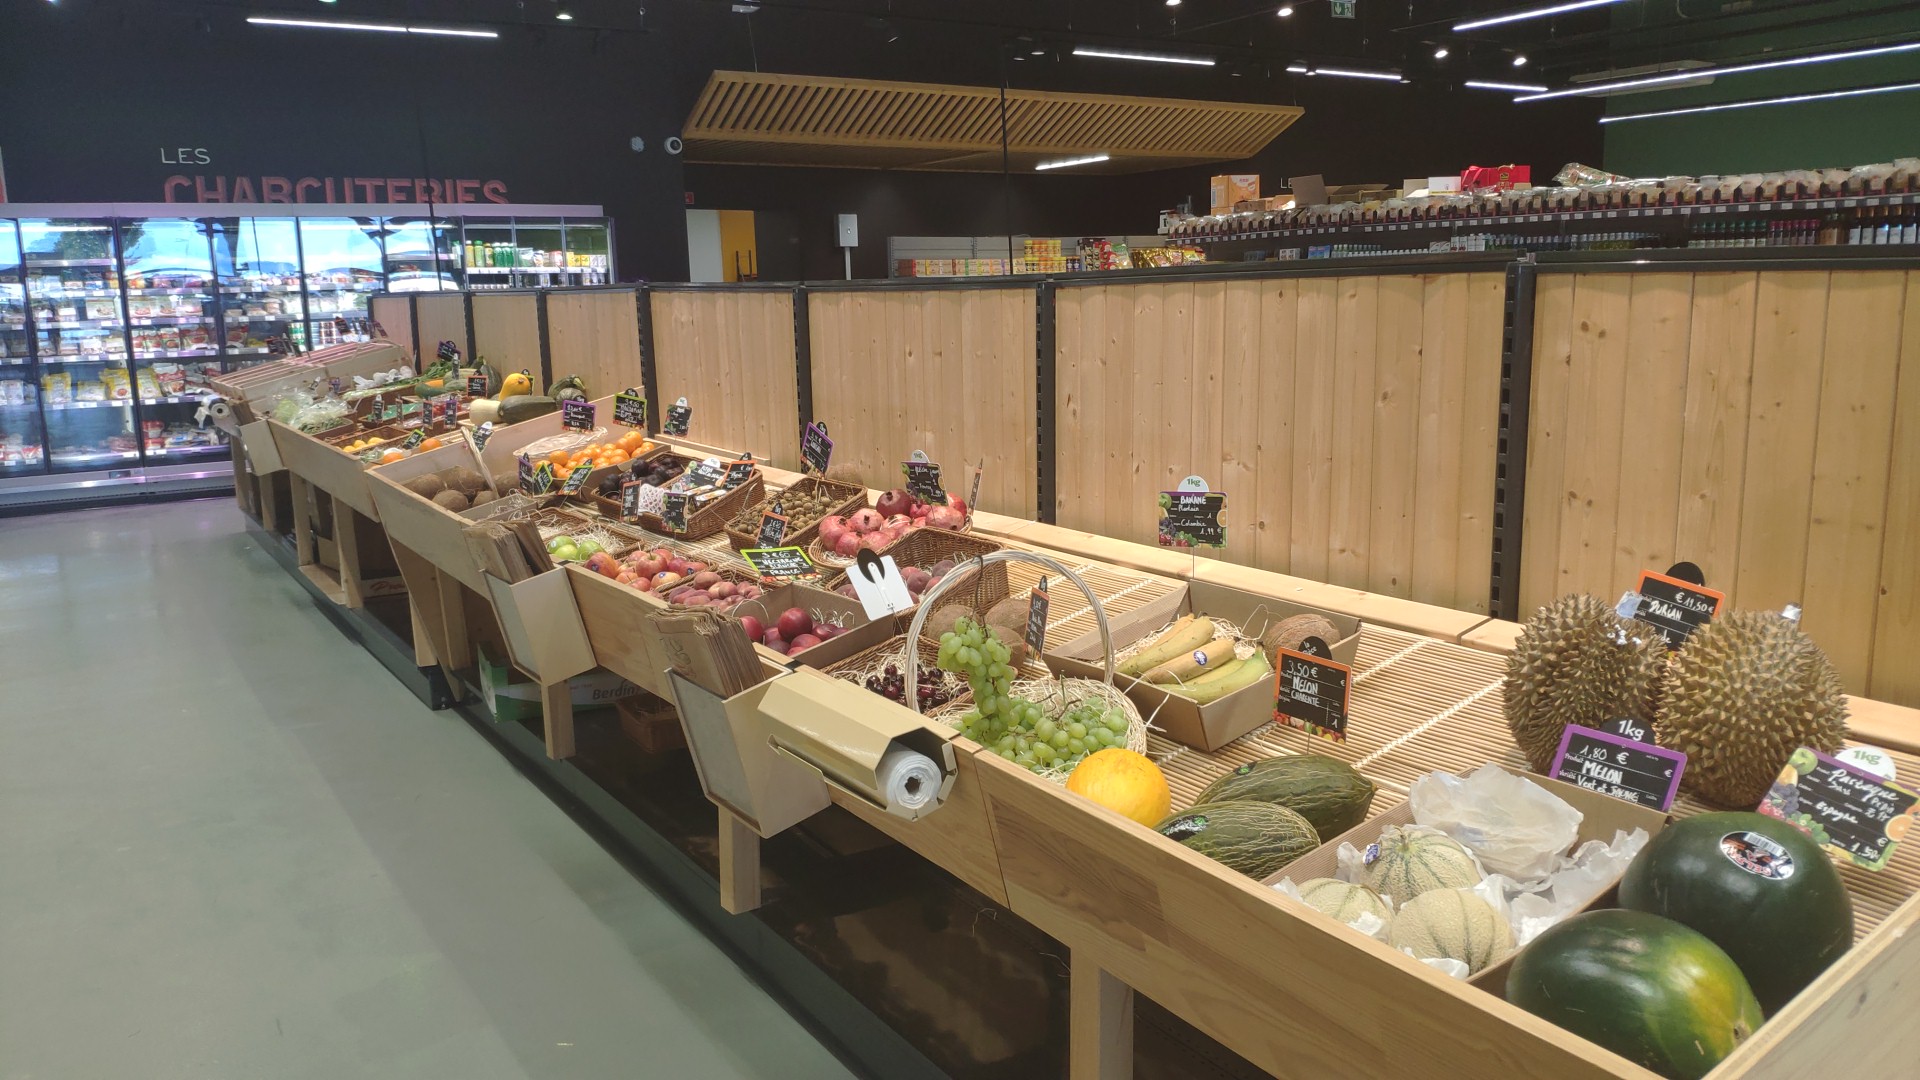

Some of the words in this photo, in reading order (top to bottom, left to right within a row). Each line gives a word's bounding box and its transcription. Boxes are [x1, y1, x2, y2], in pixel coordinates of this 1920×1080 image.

[161, 148, 211, 164] LES
[164, 175, 510, 204] CHARCUTERIES
[1186, 478, 1201, 487] 1kg
[1310, 667, 1318, 678] €
[1292, 676, 1318, 695] MELON
[1619, 720, 1645, 742] 1kg
[1580, 745, 1608, 761] 1,80
[1616, 752, 1630, 765] €
[1854, 750, 1881, 765] 1kg
[1564, 753, 1584, 764] Produit
[1582, 760, 1623, 785] MELON
[1664, 769, 1673, 778] €
[1815, 801, 1858, 823] Espagne
